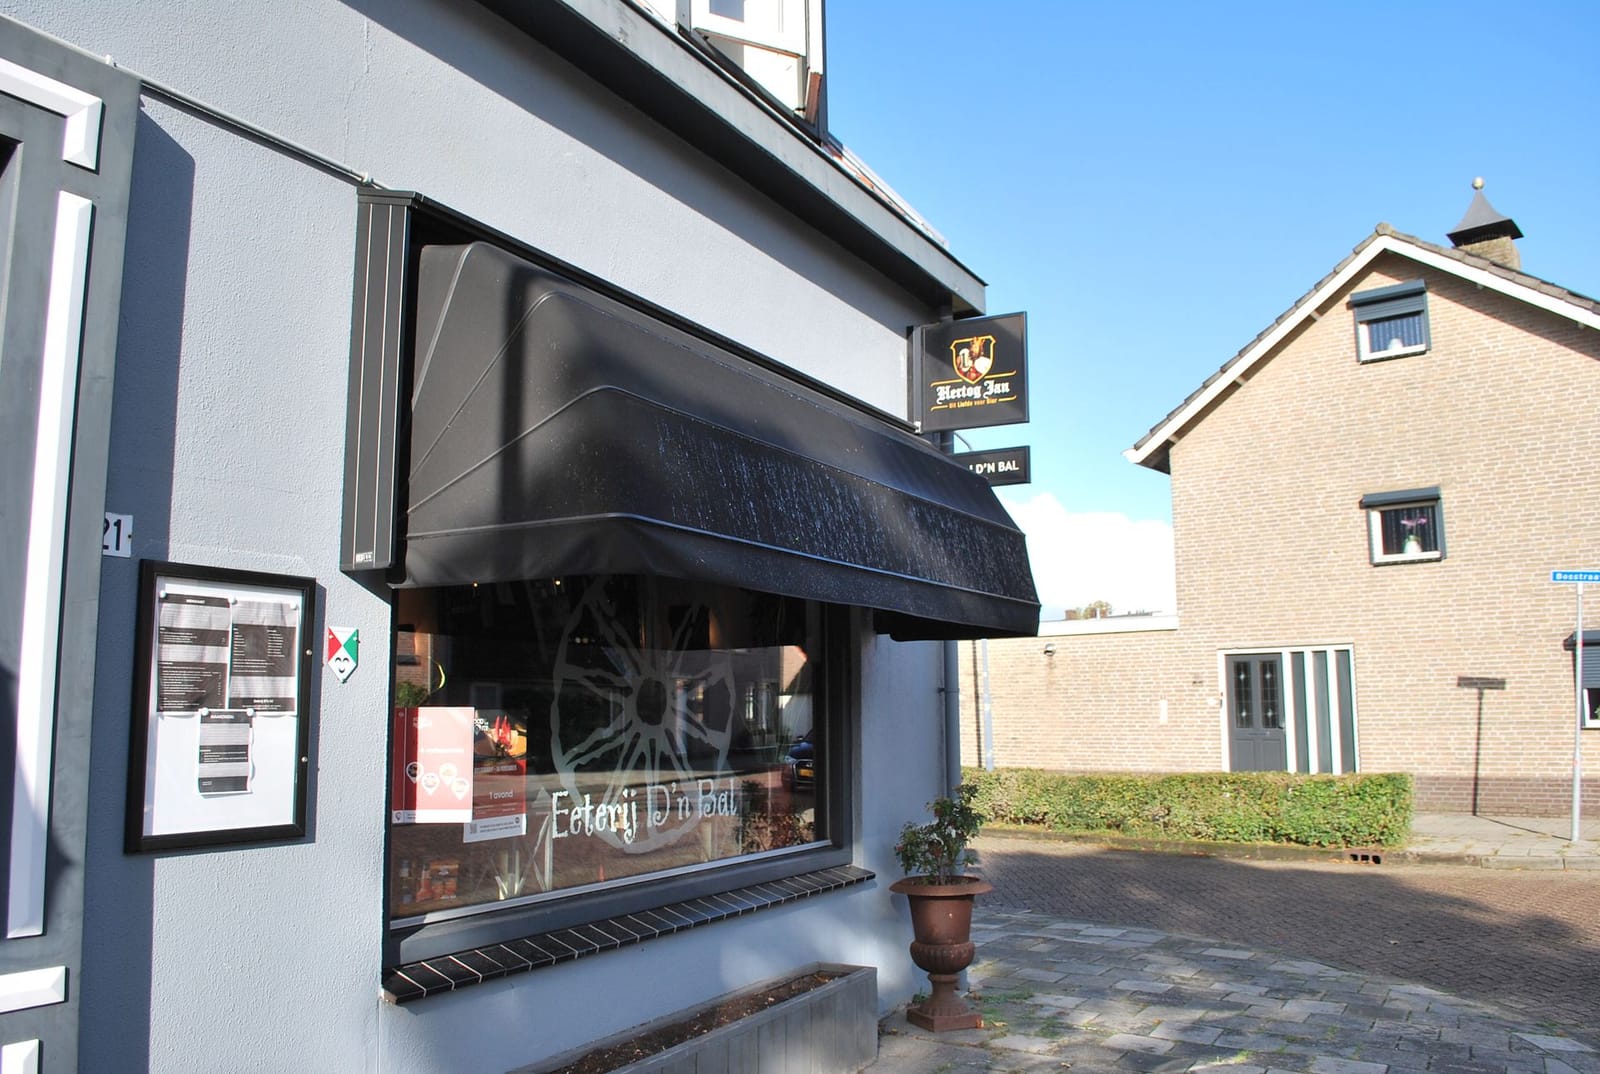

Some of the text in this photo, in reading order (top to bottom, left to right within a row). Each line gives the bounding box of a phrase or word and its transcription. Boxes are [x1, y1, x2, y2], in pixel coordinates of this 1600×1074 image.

[936, 380, 1010, 404] Hertog Jan
[975, 462, 996, 474] D'N
[997, 460, 1020, 472] BAL
[494, 788, 514, 800] avond
[551, 777, 737, 845] Eeterij D'n Bal
